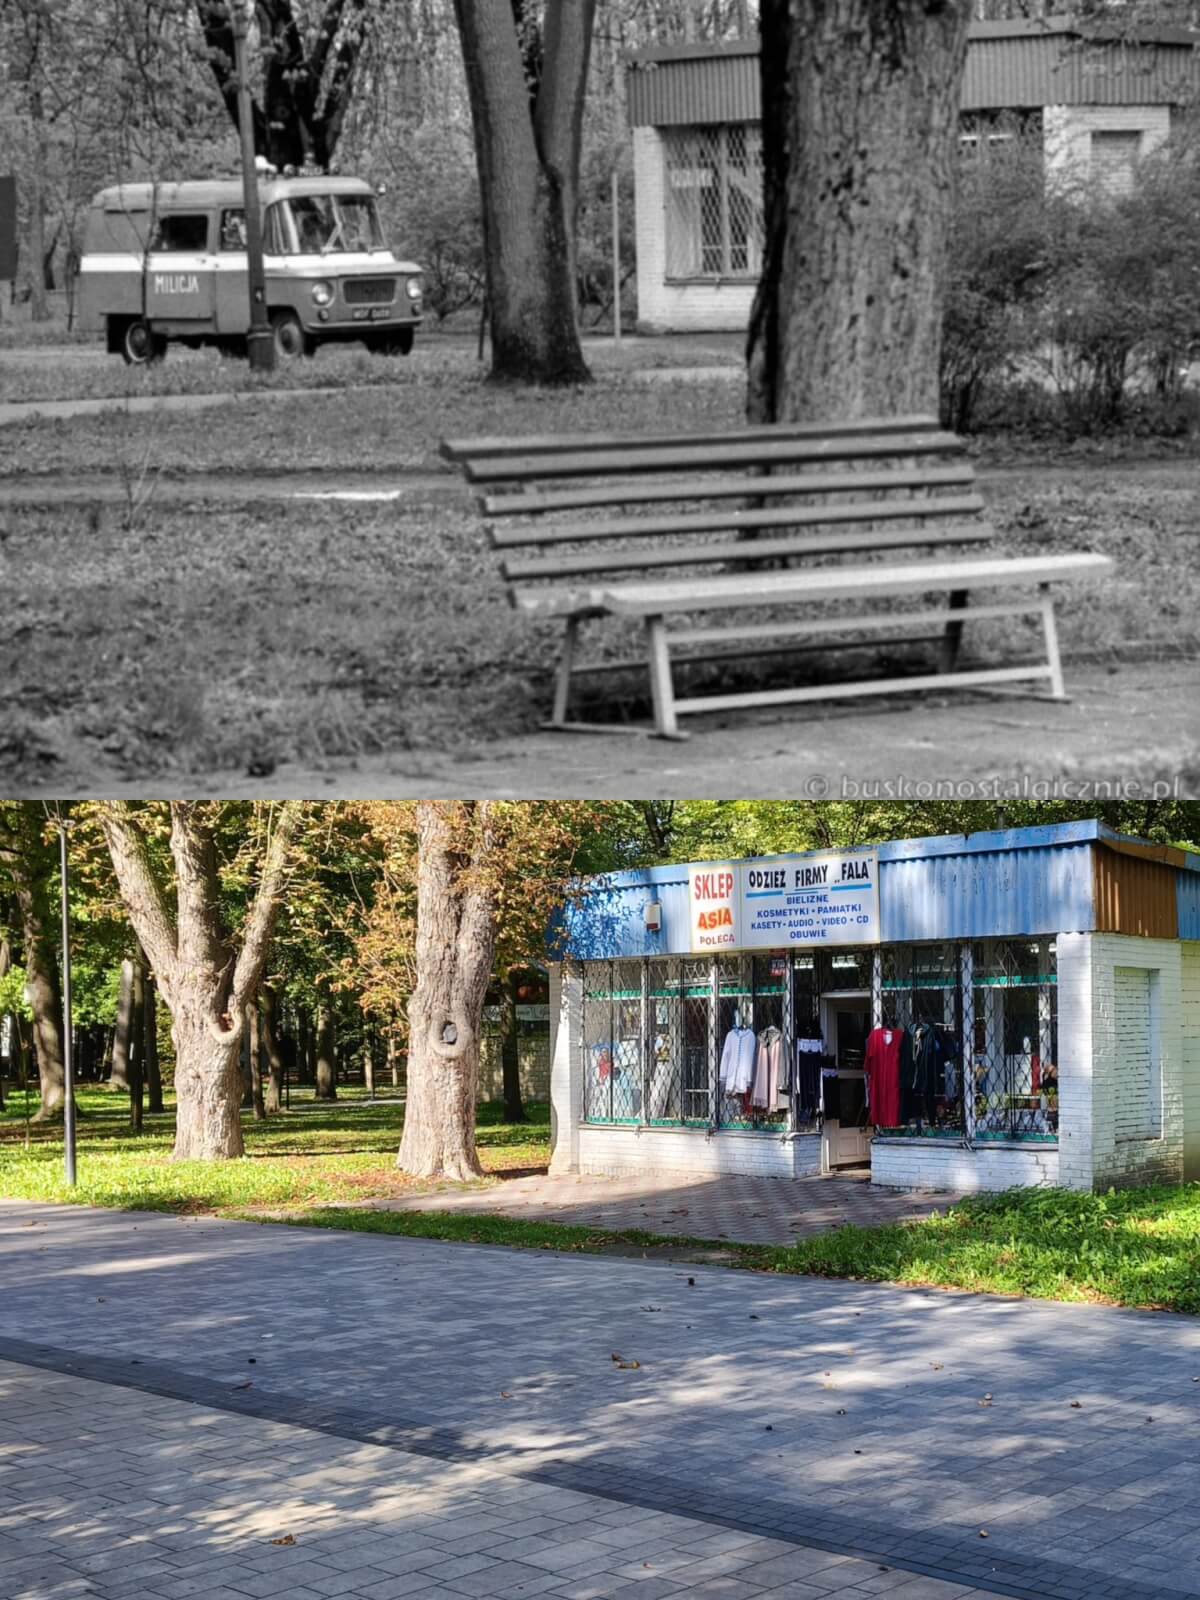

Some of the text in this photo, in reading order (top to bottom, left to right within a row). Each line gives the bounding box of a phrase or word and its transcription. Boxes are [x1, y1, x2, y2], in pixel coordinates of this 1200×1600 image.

[154, 275, 199, 294] MILICJA
[694, 872, 734, 899] SKLEP
[749, 869, 786, 889] ODZIEŻ
[795, 865, 828, 888] FIRMY
[698, 907, 733, 930] ASIA
[757, 908, 809, 918] KOSMETYKI
[751, 915, 869, 930] KASETY AUDIO VIDEO CD
[699, 933, 735, 946] POLECA
[790, 929, 828, 940] OBUWIE
